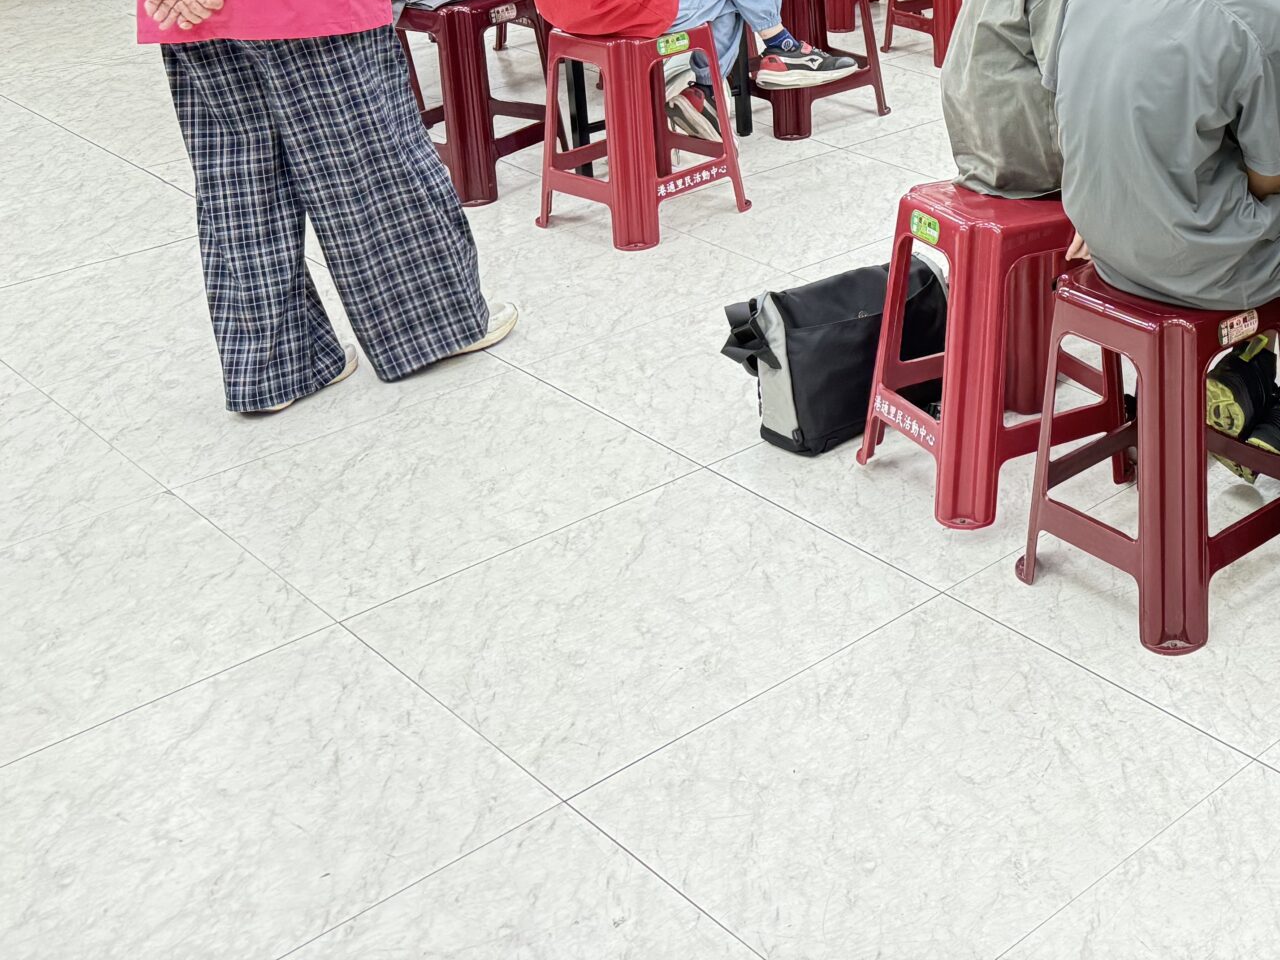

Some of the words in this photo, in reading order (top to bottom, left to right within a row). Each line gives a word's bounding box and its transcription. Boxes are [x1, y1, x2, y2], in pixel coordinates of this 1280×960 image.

[657, 165, 727, 197] 港通里民活動中心
[874, 395, 935, 446] 港通里民活動中心
